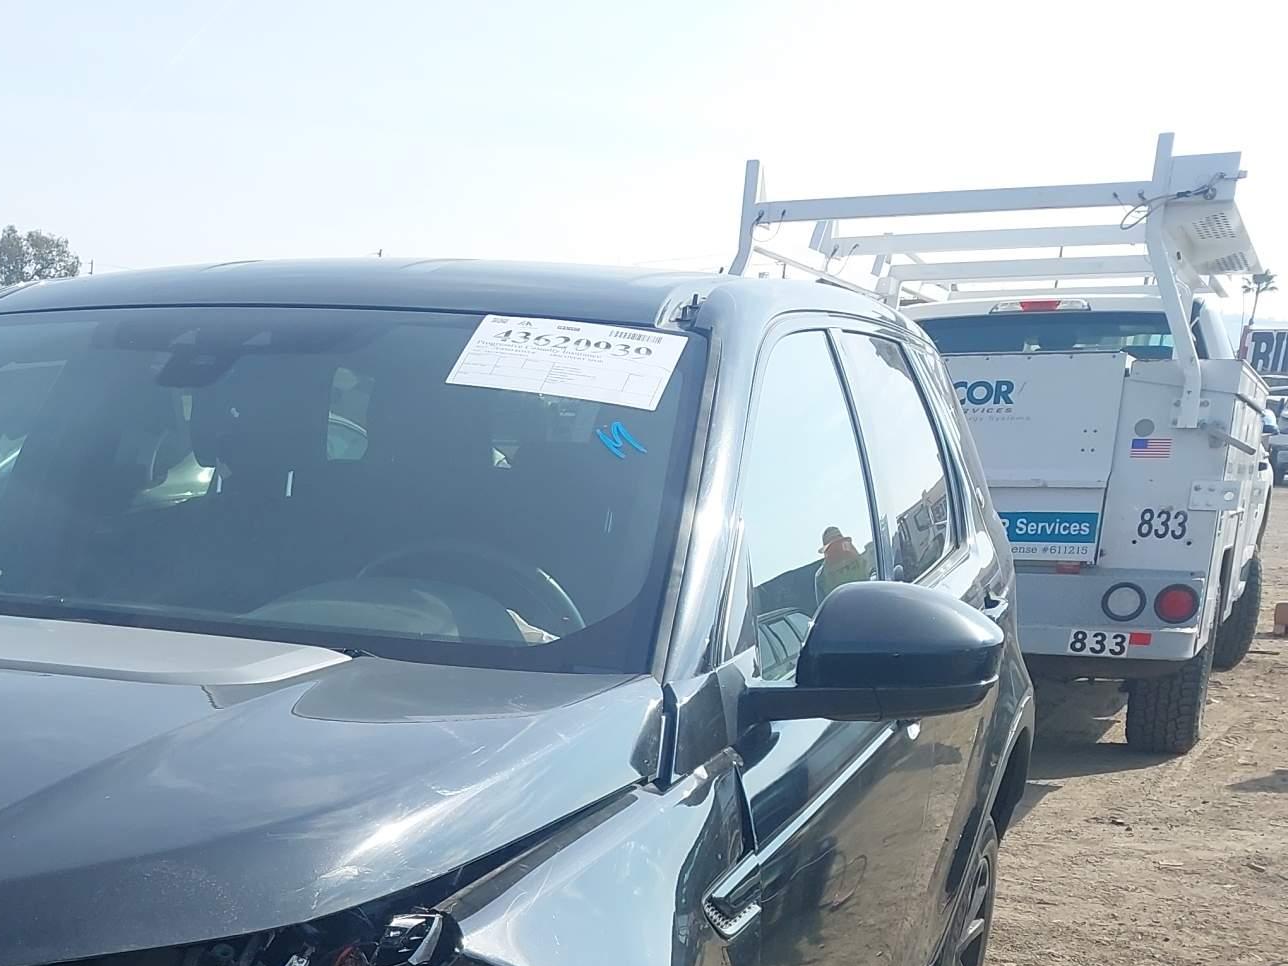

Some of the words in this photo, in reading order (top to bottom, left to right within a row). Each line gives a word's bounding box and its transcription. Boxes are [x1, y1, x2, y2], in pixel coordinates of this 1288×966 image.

[1015, 518, 1090, 535] Services
[1137, 508, 1188, 540] 833
[1042, 545, 1088, 555] #611215
[1069, 630, 1127, 656] 833
